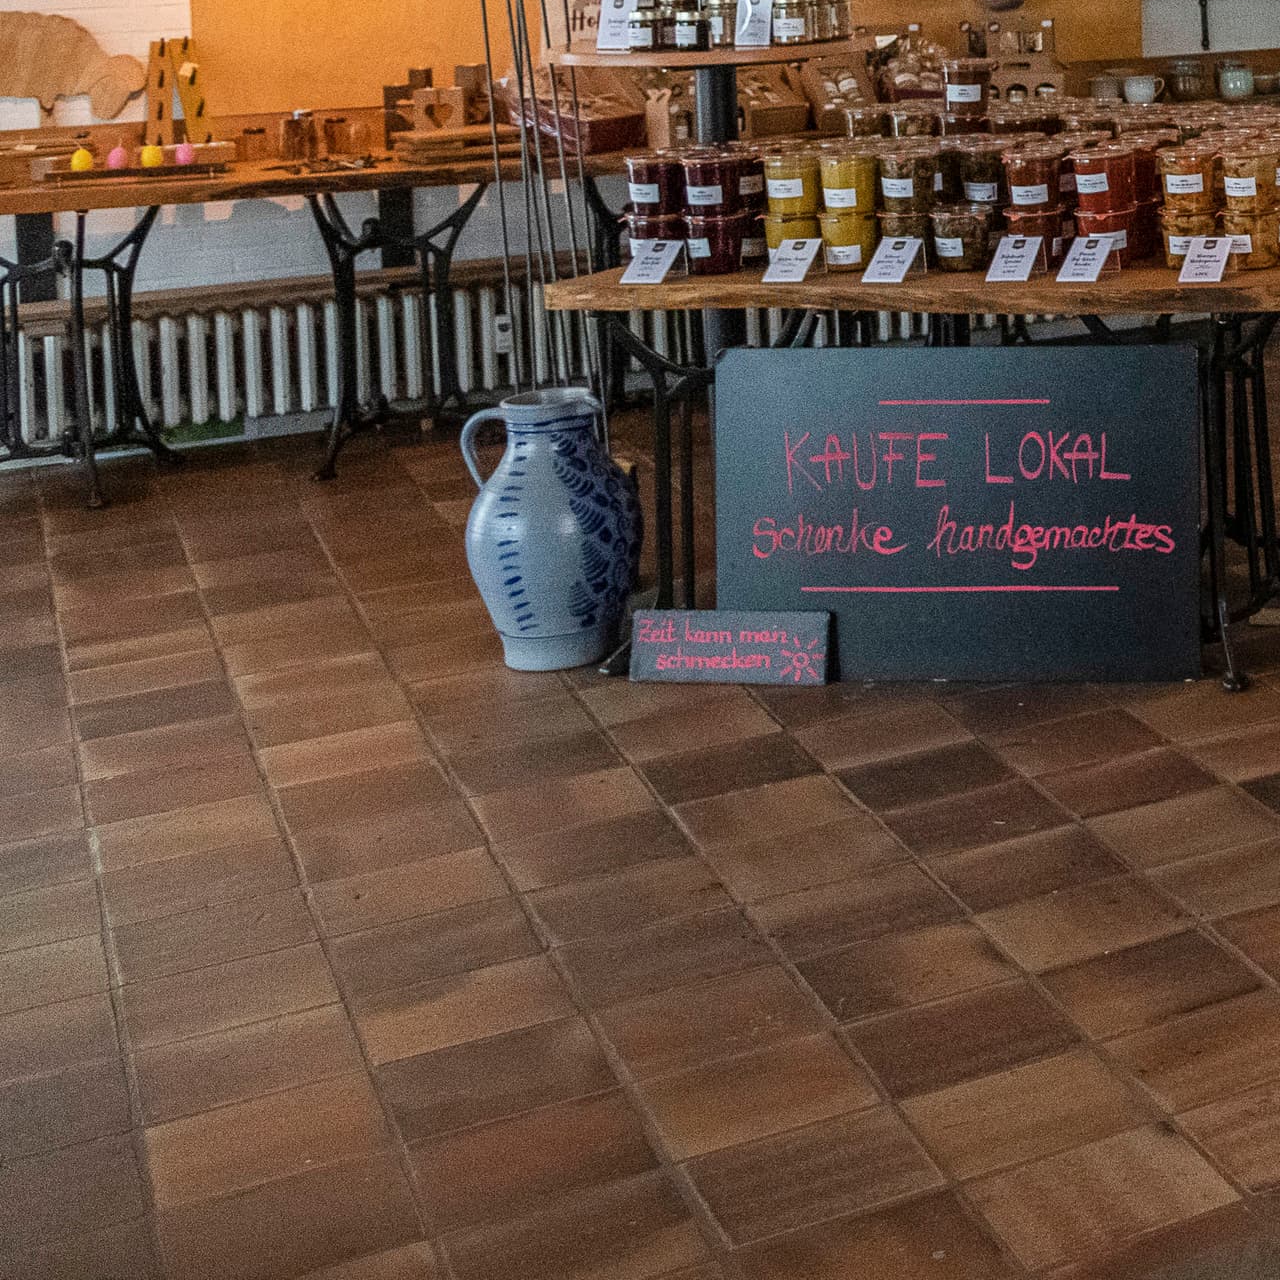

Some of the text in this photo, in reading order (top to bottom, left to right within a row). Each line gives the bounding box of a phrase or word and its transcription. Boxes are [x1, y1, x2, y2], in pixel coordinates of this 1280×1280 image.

[783, 429, 1131, 494] KAUFE LOKAL
[752, 500, 1176, 570] Schenke handgemachtes
[637, 618, 676, 644] Zeit
[684, 619, 733, 644] kann
[655, 648, 771, 671] schmecken
